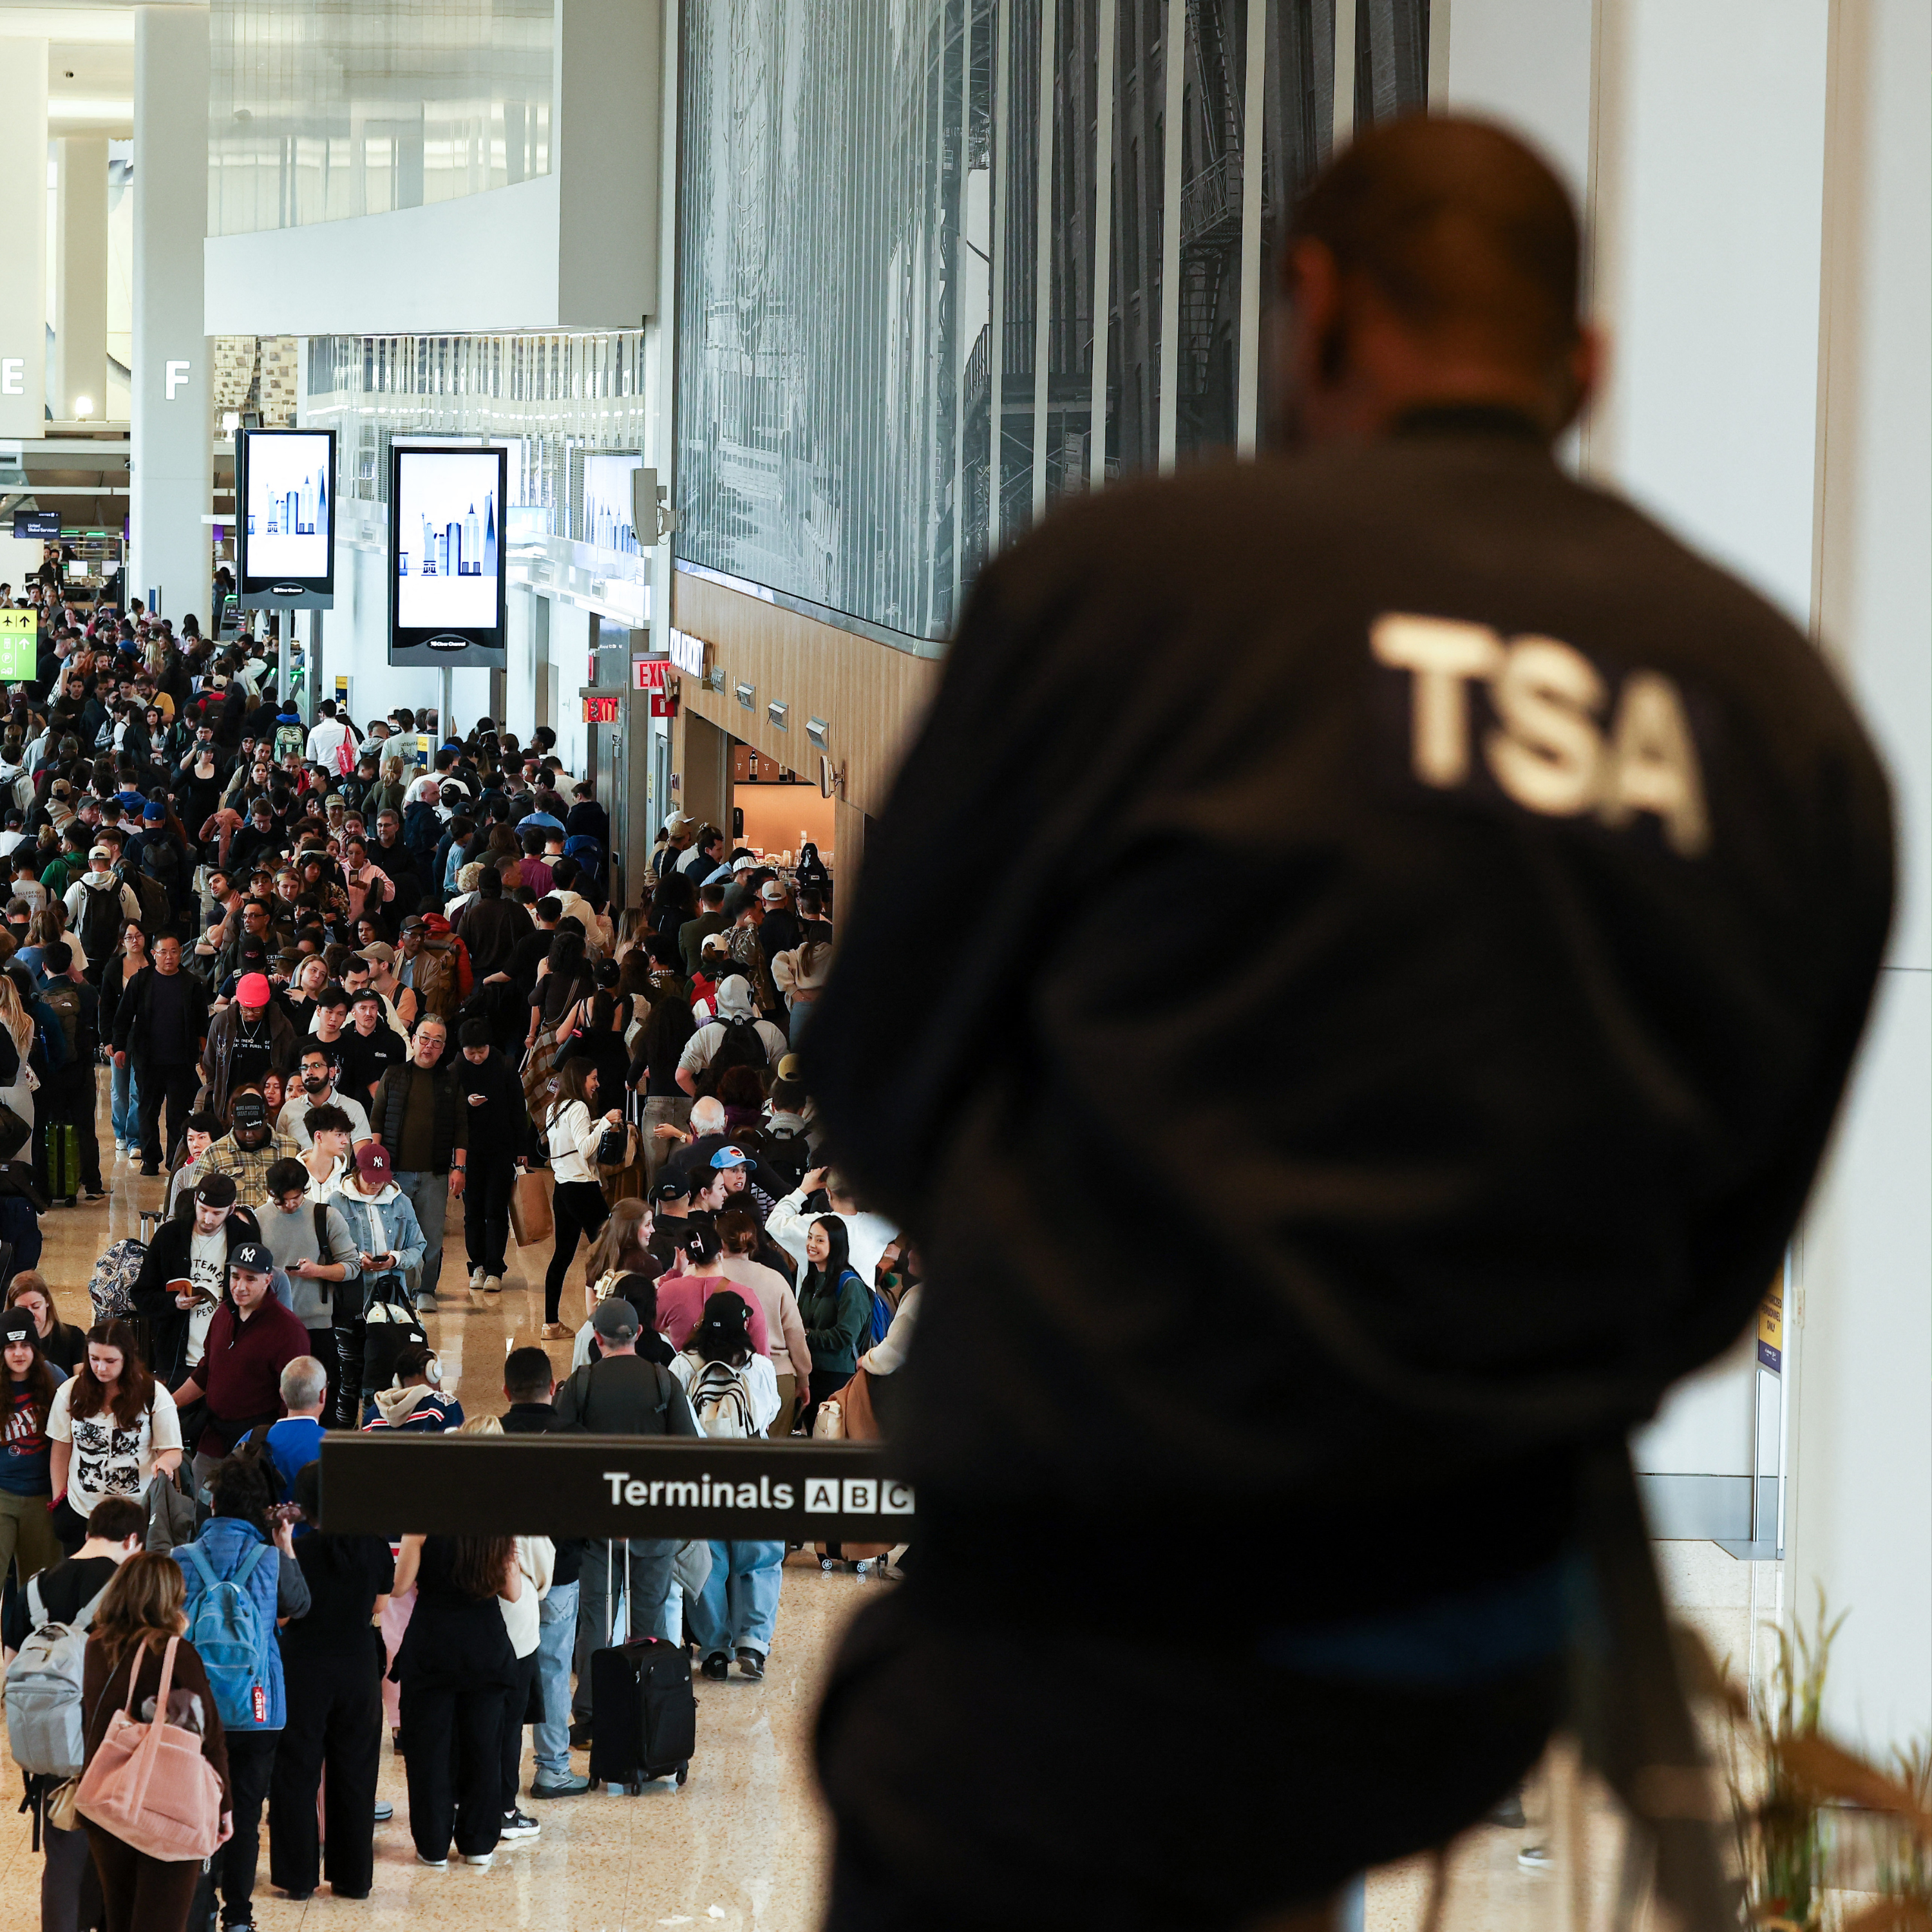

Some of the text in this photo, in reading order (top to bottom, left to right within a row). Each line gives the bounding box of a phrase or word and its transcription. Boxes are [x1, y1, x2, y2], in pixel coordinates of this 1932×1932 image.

[1, 358, 24, 395] E
[166, 361, 191, 400] F
[639, 663, 670, 687] EXIT
[587, 697, 618, 721] EXIT
[1368, 612, 1711, 858] TSA
[603, 1472, 795, 1510] Terminals
